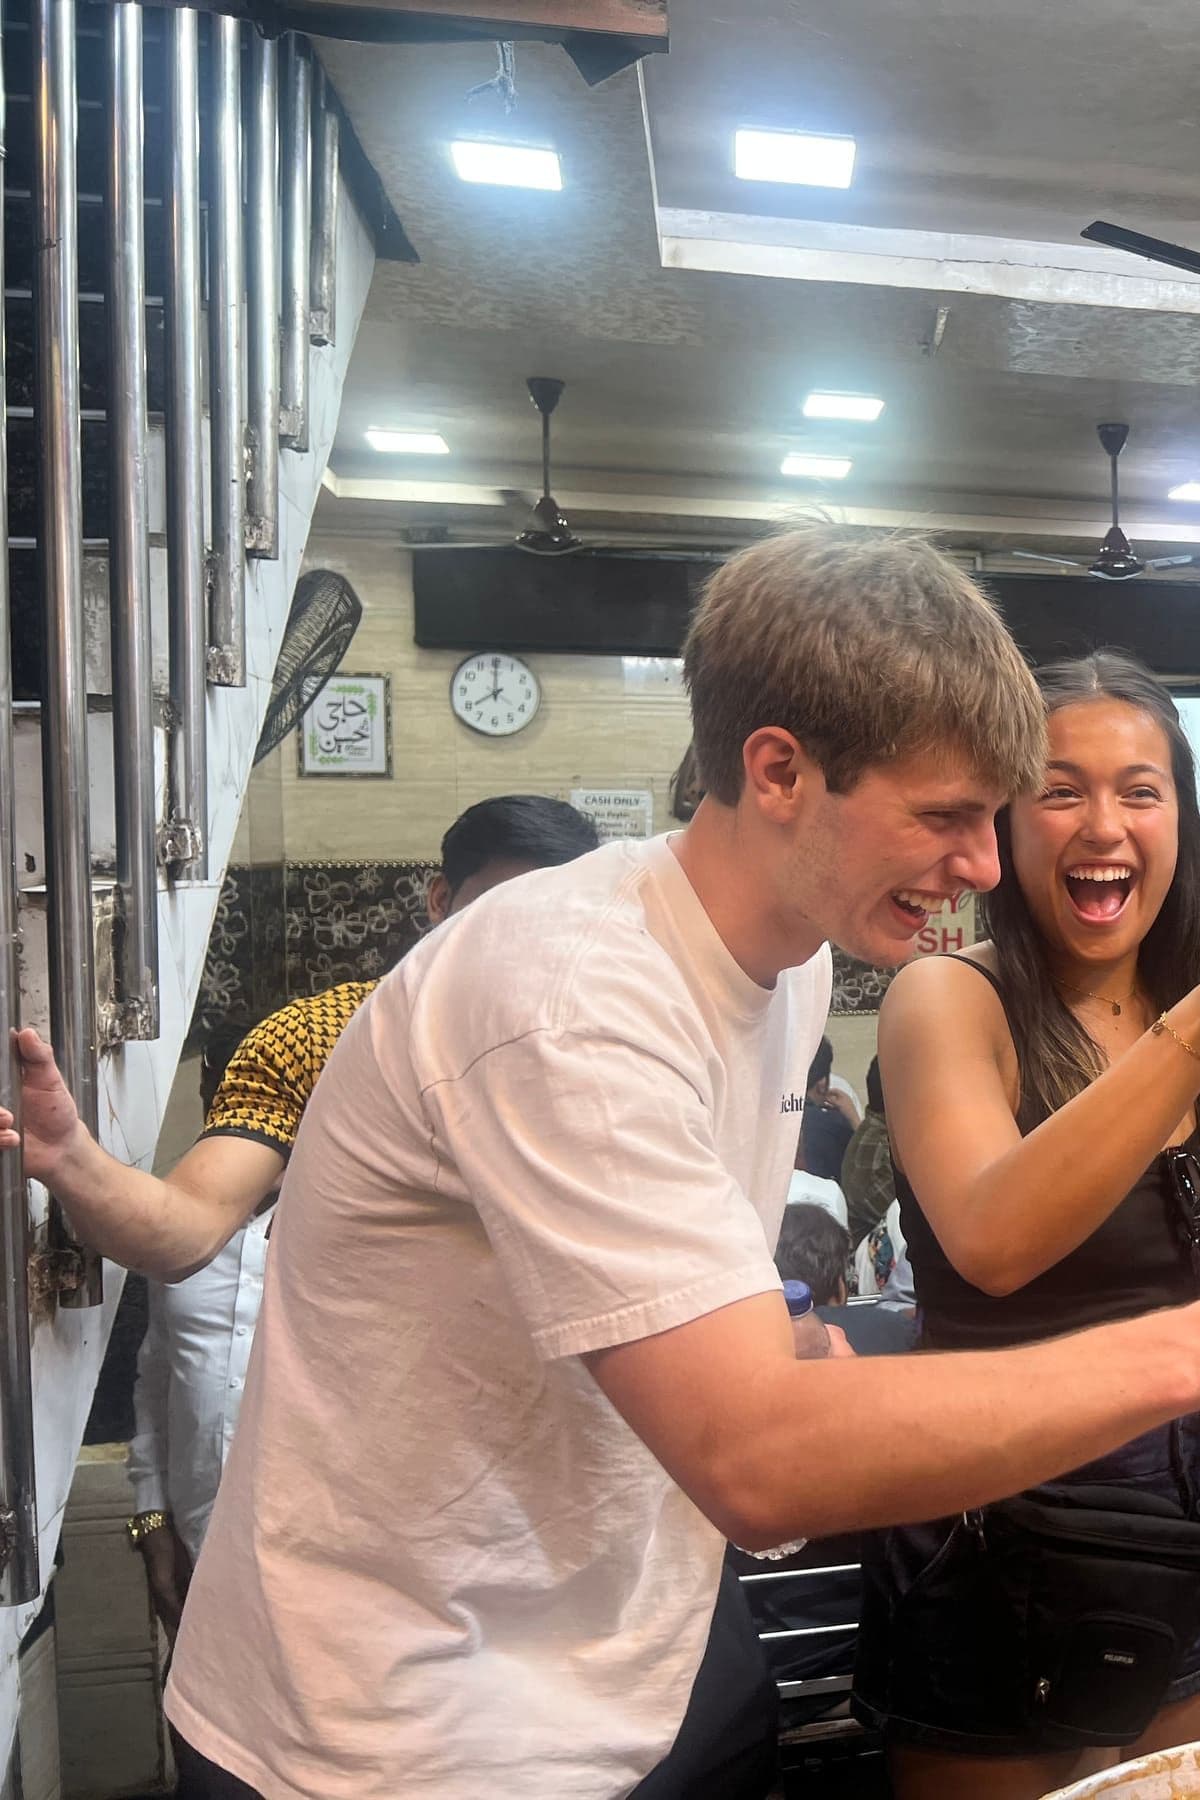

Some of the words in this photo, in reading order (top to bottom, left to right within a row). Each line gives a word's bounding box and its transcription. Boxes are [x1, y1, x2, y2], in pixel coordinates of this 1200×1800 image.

[477, 661, 484, 672] 11
[464, 671, 476, 681] 10
[519, 673, 527, 685] 2
[525, 688, 532, 699] 3
[476, 711, 483, 722] 7
[491, 716, 499, 727] 6
[507, 712, 514, 724] 5
[584, 796, 611, 805] CASH
[613, 797, 640, 806] ONLY
[917, 927, 963, 954] SH
